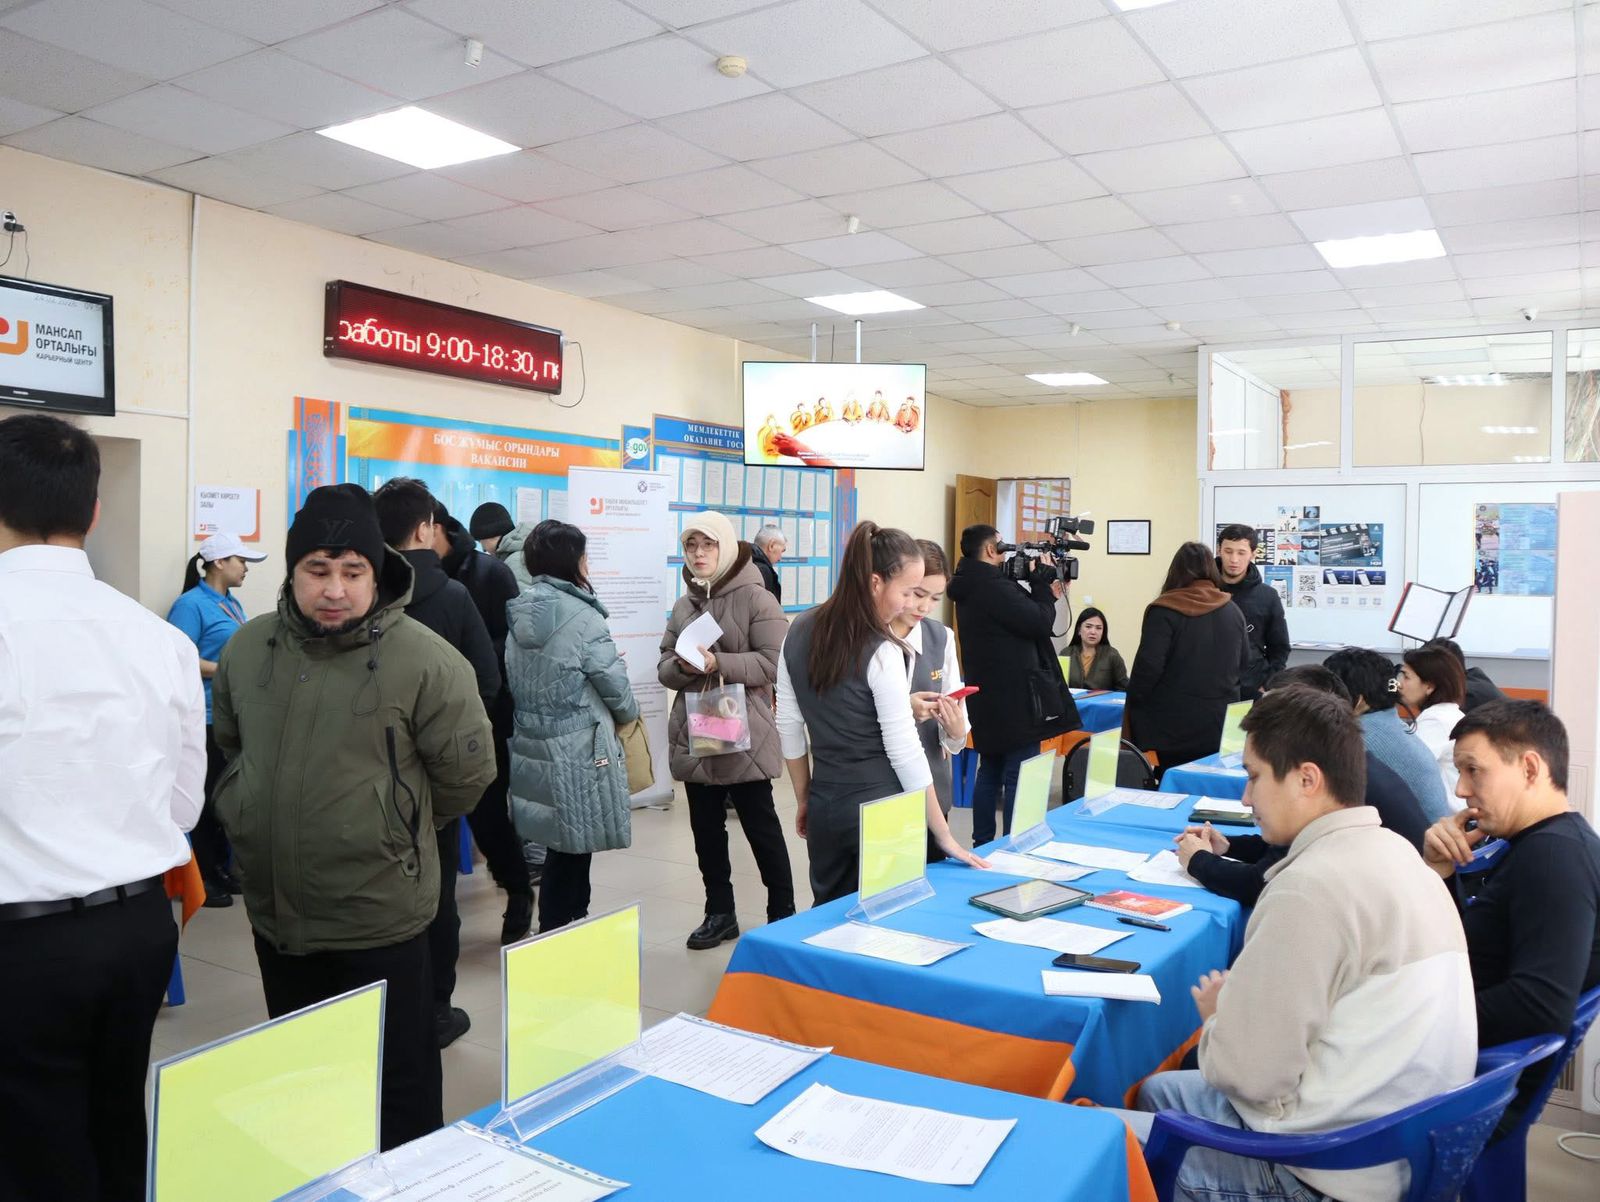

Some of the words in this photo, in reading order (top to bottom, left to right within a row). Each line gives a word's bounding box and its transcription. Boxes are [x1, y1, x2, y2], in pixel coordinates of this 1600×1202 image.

[35, 323, 82, 341] МАНСАП
[35, 338, 97, 357] ОРТАЛЫҒЫ
[426, 333, 539, 381] 9:00-18:30,
[687, 423, 740, 439] МЕМЛЕКЕТТІК
[433, 433, 456, 447] БОС
[504, 441, 560, 457] ОРЫНДАРЫ
[683, 434, 724, 447] ОКАЗАНИЕ
[471, 453, 527, 469] ВАКАНСИИ
[1266, 531, 1276, 564] ANTIKOR
